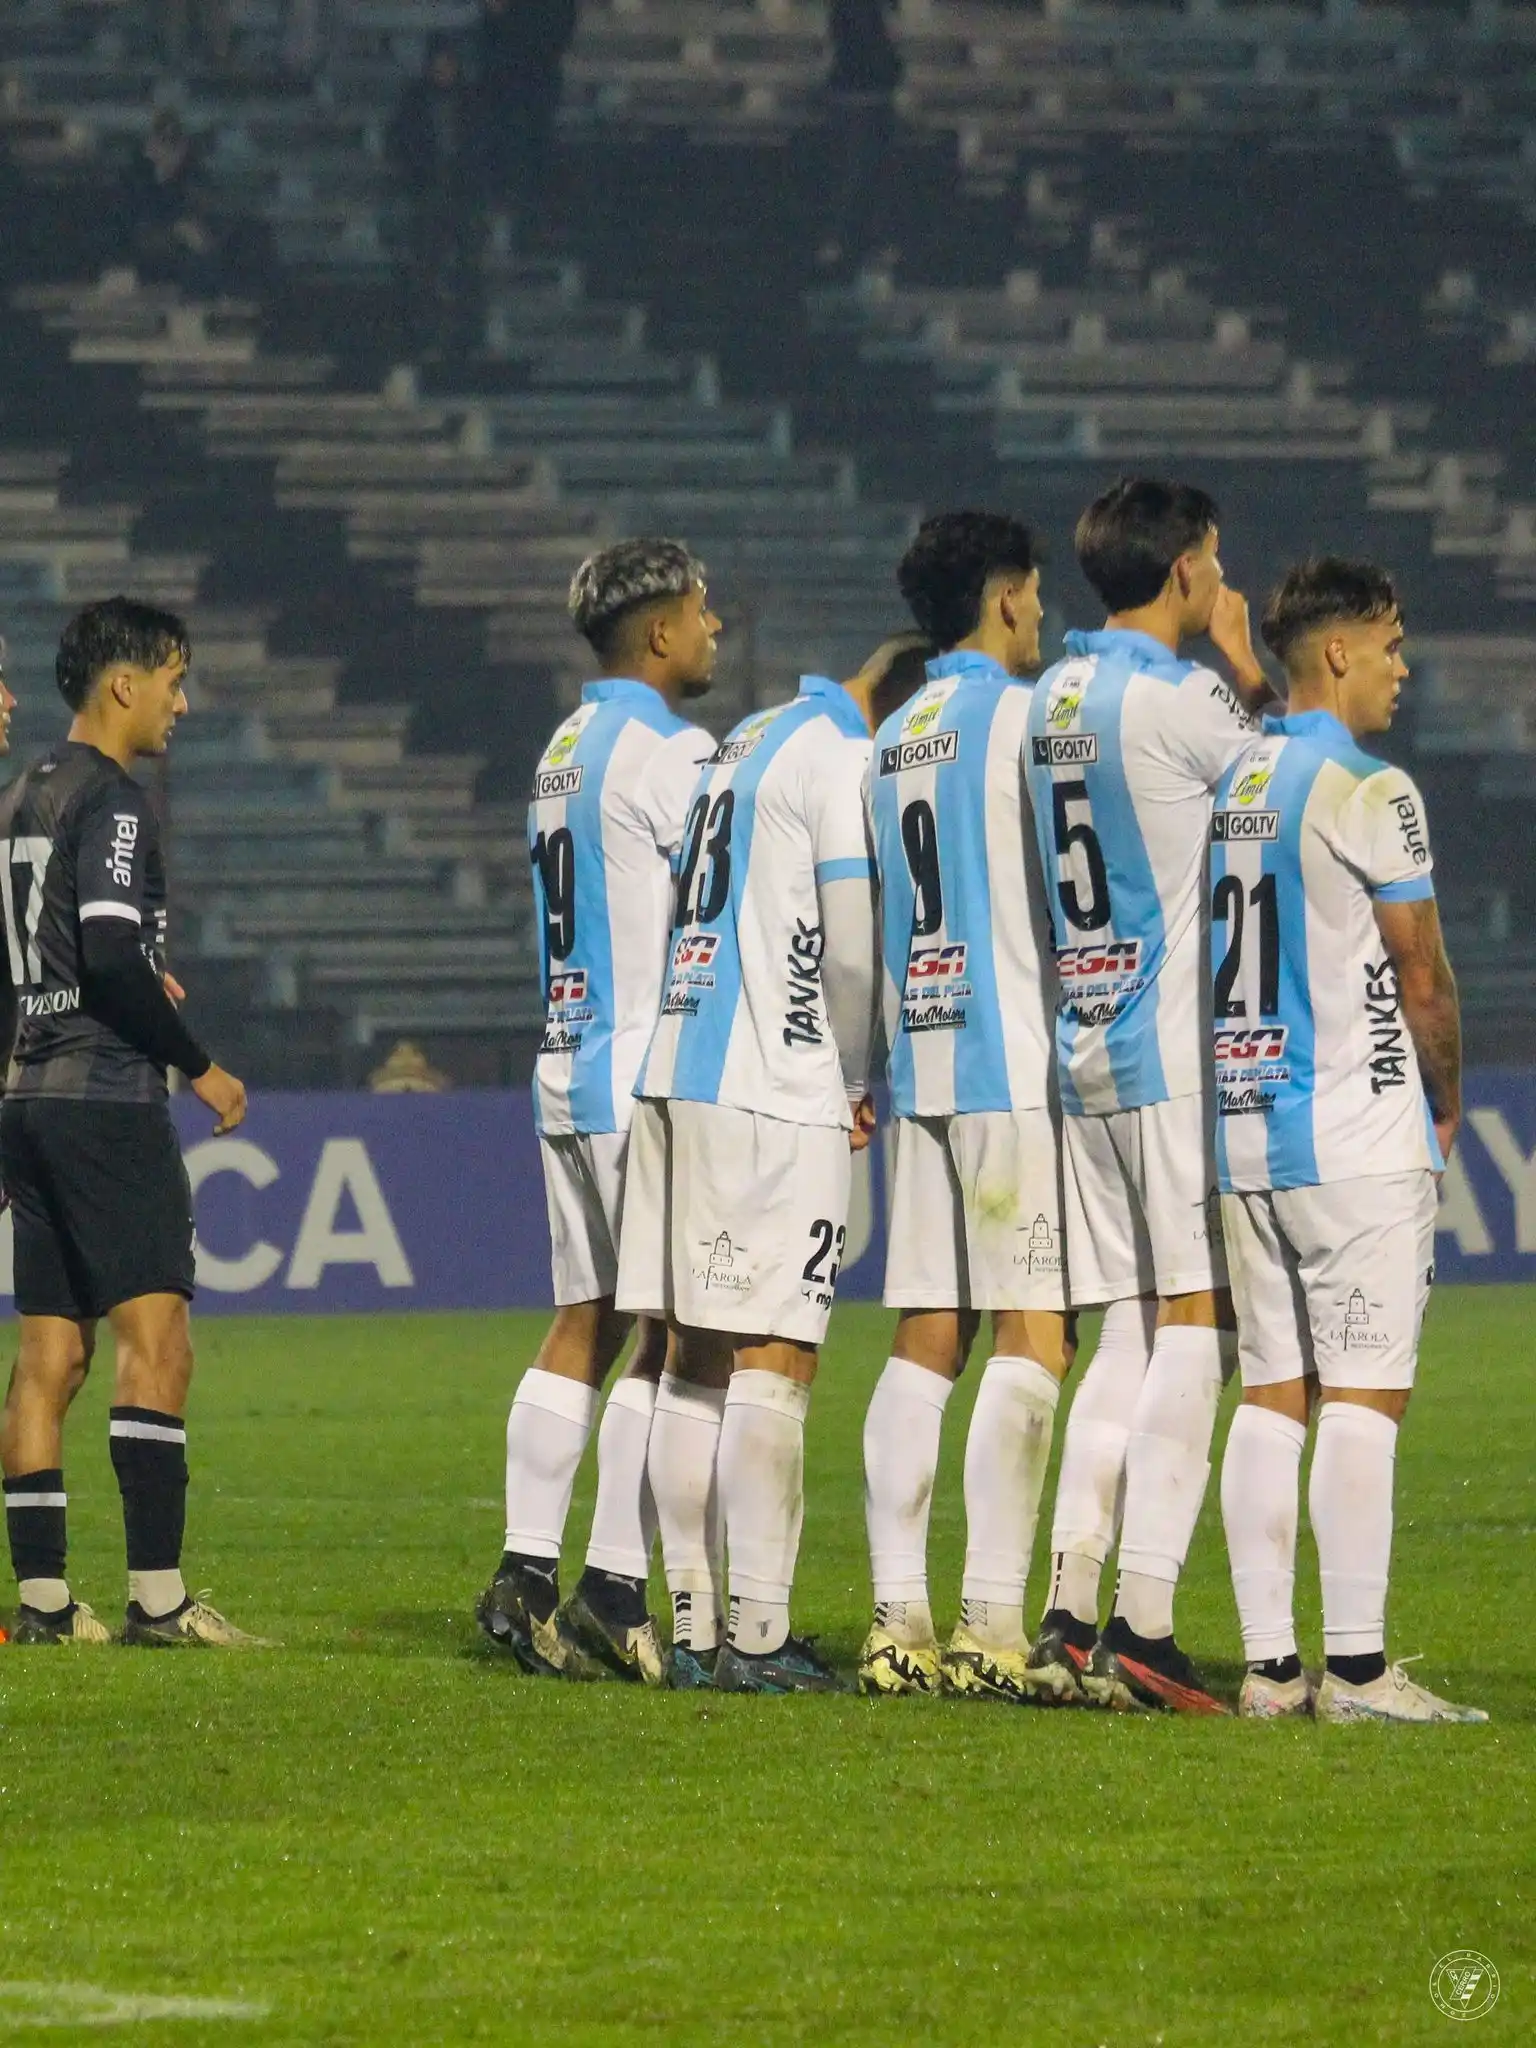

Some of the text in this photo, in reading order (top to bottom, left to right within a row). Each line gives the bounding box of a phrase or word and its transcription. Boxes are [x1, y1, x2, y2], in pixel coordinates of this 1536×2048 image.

[541, 771, 580, 794] GOLTV
[903, 737, 952, 763] GOLTV
[1053, 740, 1092, 760] GOLTV
[105, 814, 139, 887] antel
[675, 789, 735, 928] 23
[902, 800, 943, 937] 9
[1052, 780, 1111, 931] 5
[1231, 816, 1276, 835] GOLTV
[1389, 795, 1427, 865] antel
[0, 836, 53, 985] 17
[530, 827, 575, 961] 19
[1213, 873, 1279, 1017] 21
[20, 986, 80, 1016] VISION
[783, 917, 826, 1047] TANKES
[1364, 957, 1406, 1095] TANKES
